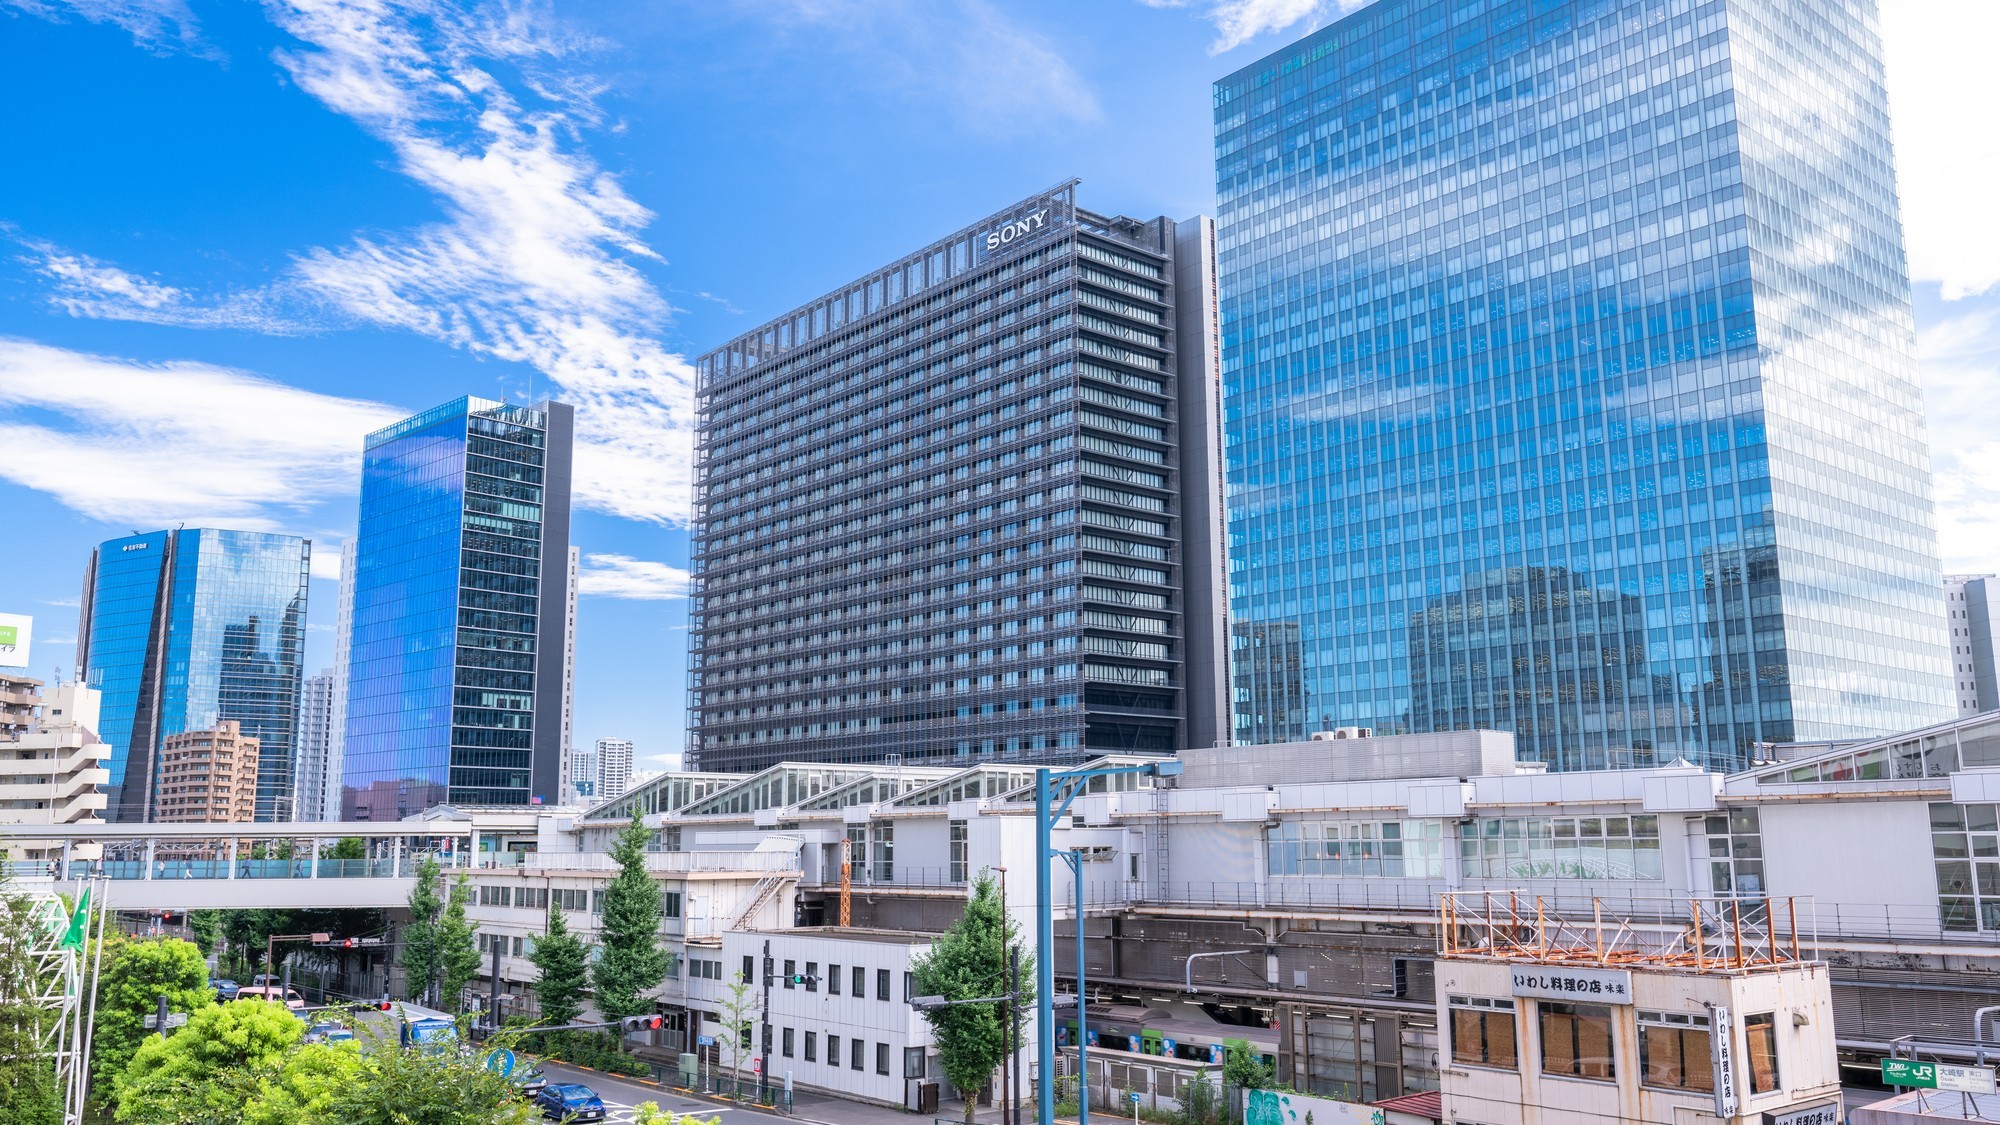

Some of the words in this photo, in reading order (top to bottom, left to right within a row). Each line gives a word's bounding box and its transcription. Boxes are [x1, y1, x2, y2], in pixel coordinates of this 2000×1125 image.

[987, 209, 1048, 250] SONY
[1513, 973, 1602, 994] いわし料理の店
[1604, 982, 1625, 995] 味楽
[1889, 1062, 1905, 1070] TWR
[1912, 1066, 1933, 1077] JR
